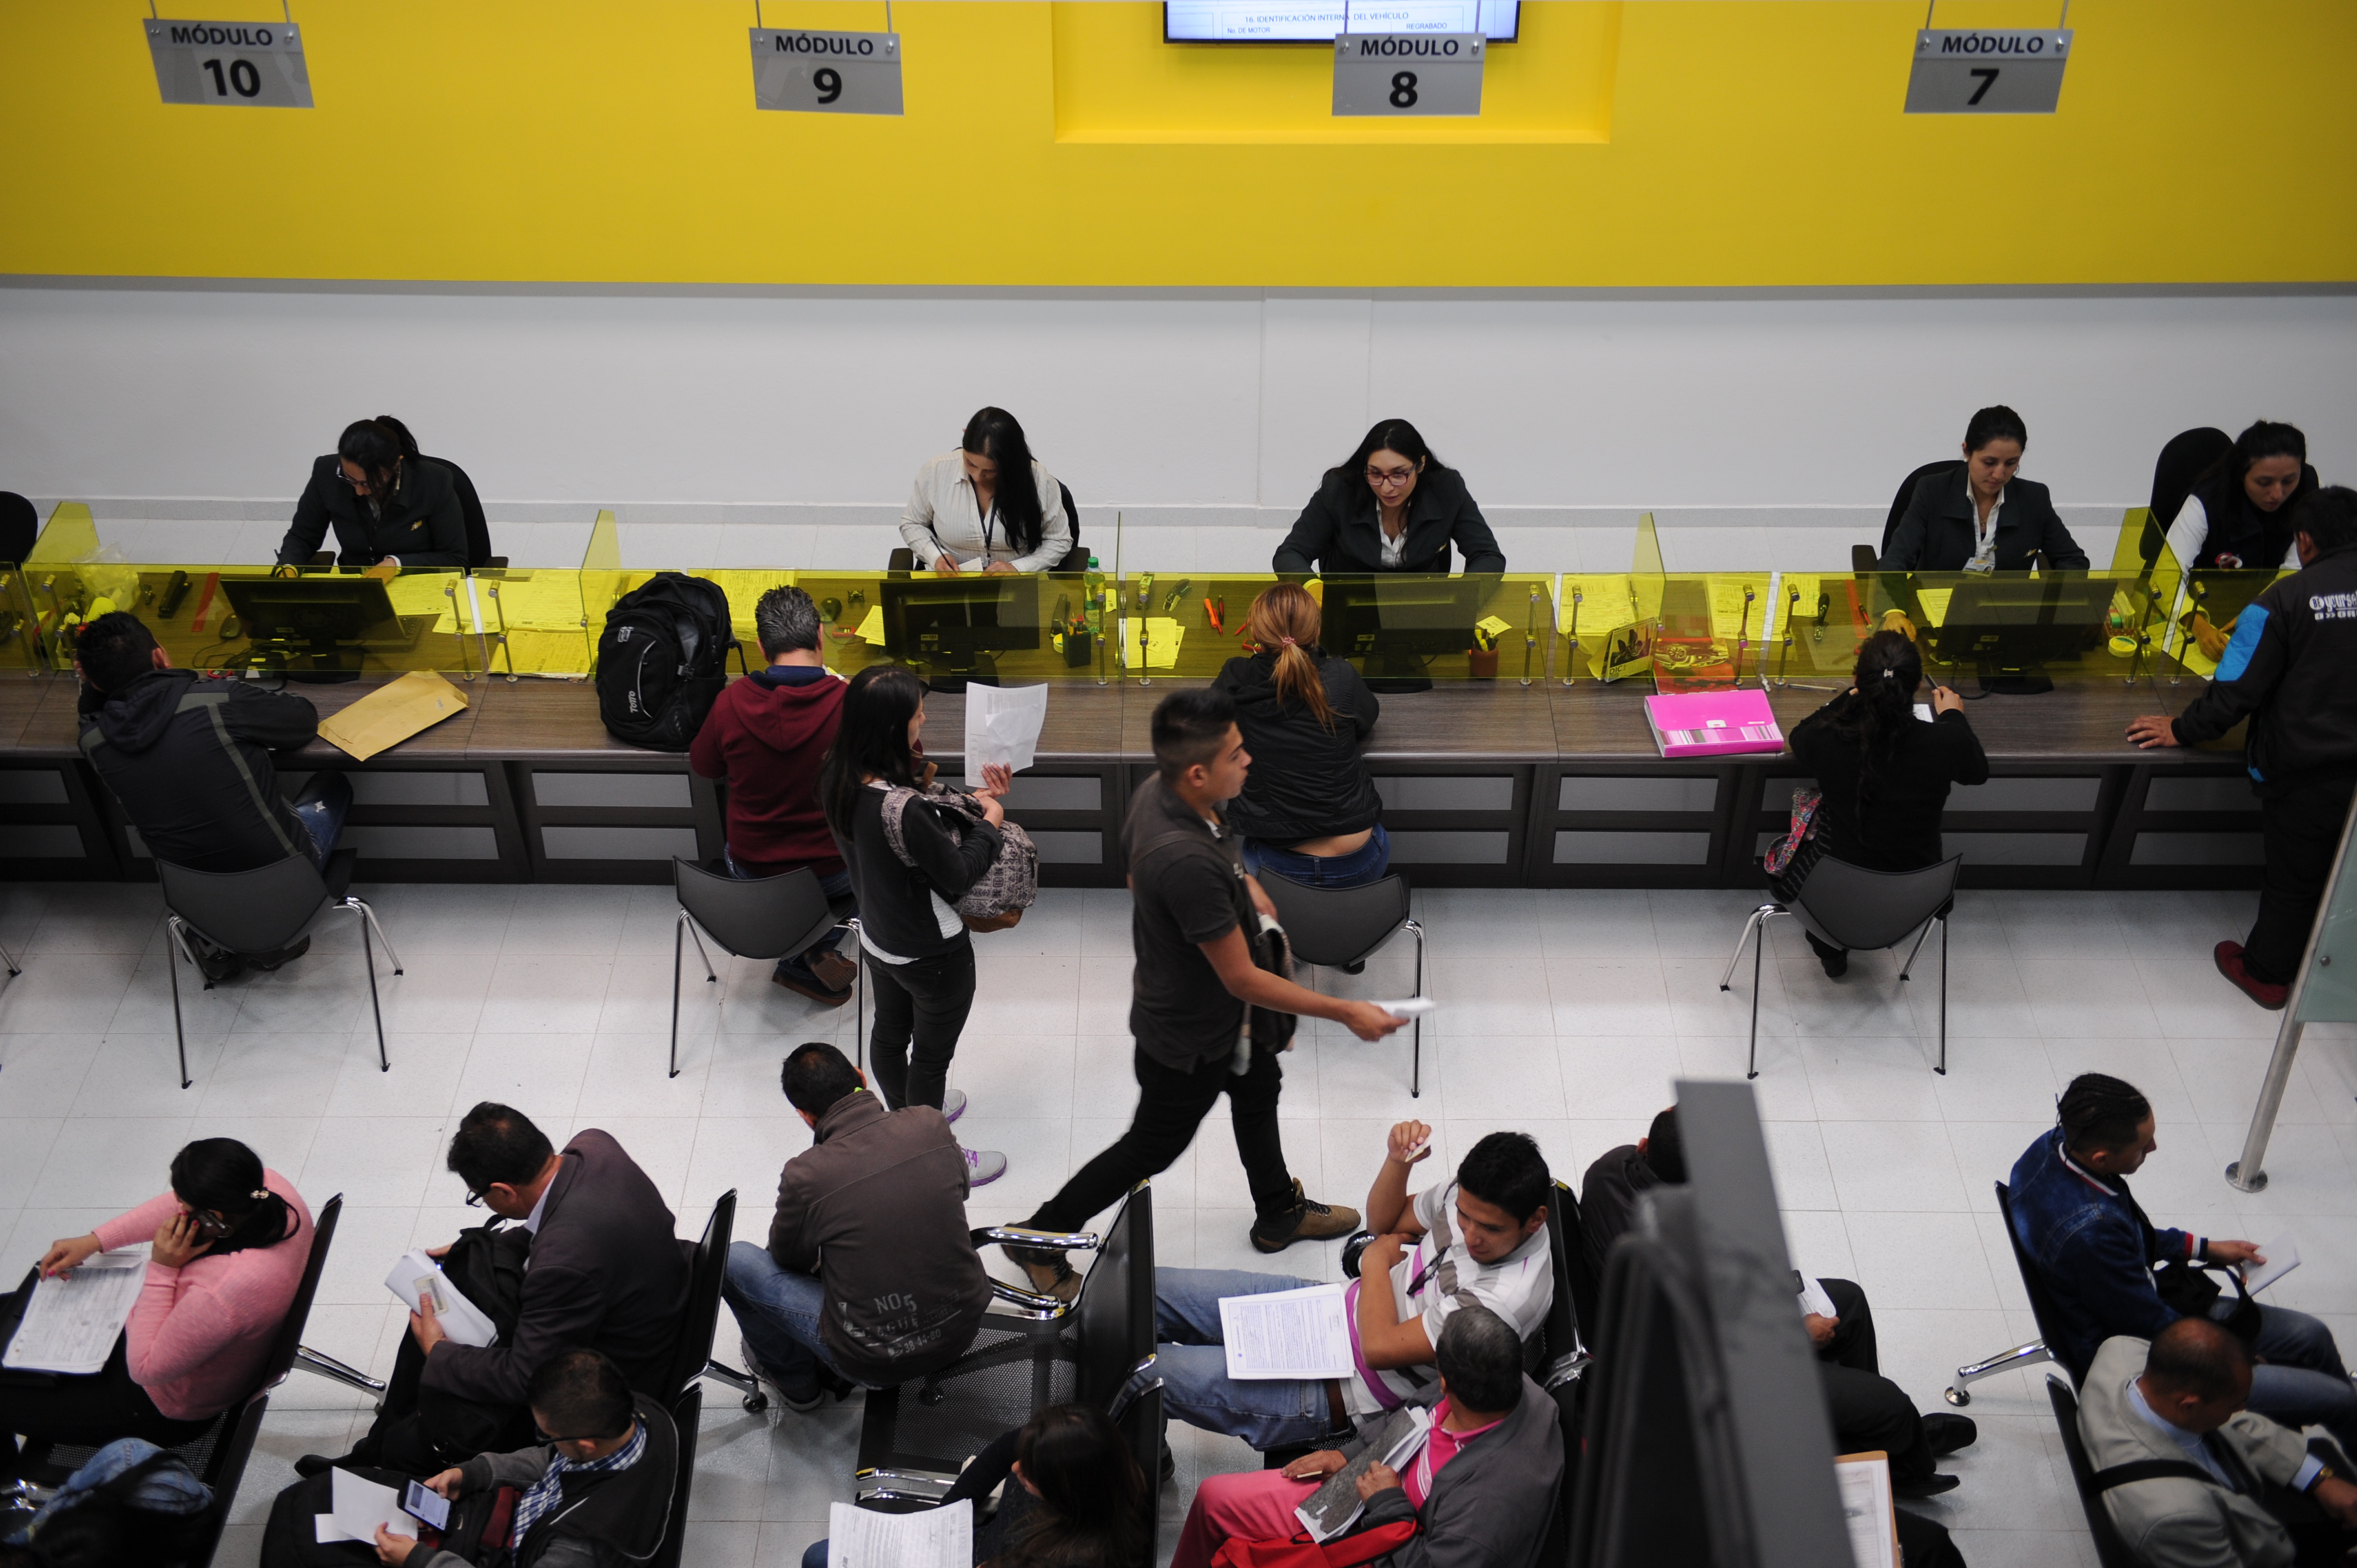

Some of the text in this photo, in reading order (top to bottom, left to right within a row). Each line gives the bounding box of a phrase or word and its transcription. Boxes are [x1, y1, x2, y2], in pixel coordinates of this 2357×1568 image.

[1257, 14, 1316, 23] IDENTIFICACIÓN
[1370, 12, 1409, 20] VEHÍCULO
[171, 24, 272, 46] MÓDULO
[775, 33, 874, 56] MÓDULO
[1360, 35, 1459, 56] MÓDULO
[1941, 33, 2044, 54] MÓDULO
[202, 59, 261, 98] 10
[812, 67, 842, 104] 9
[1389, 70, 1418, 109] 8
[1967, 68, 2000, 105] 7
[1609, 665, 1623, 675] DIC
